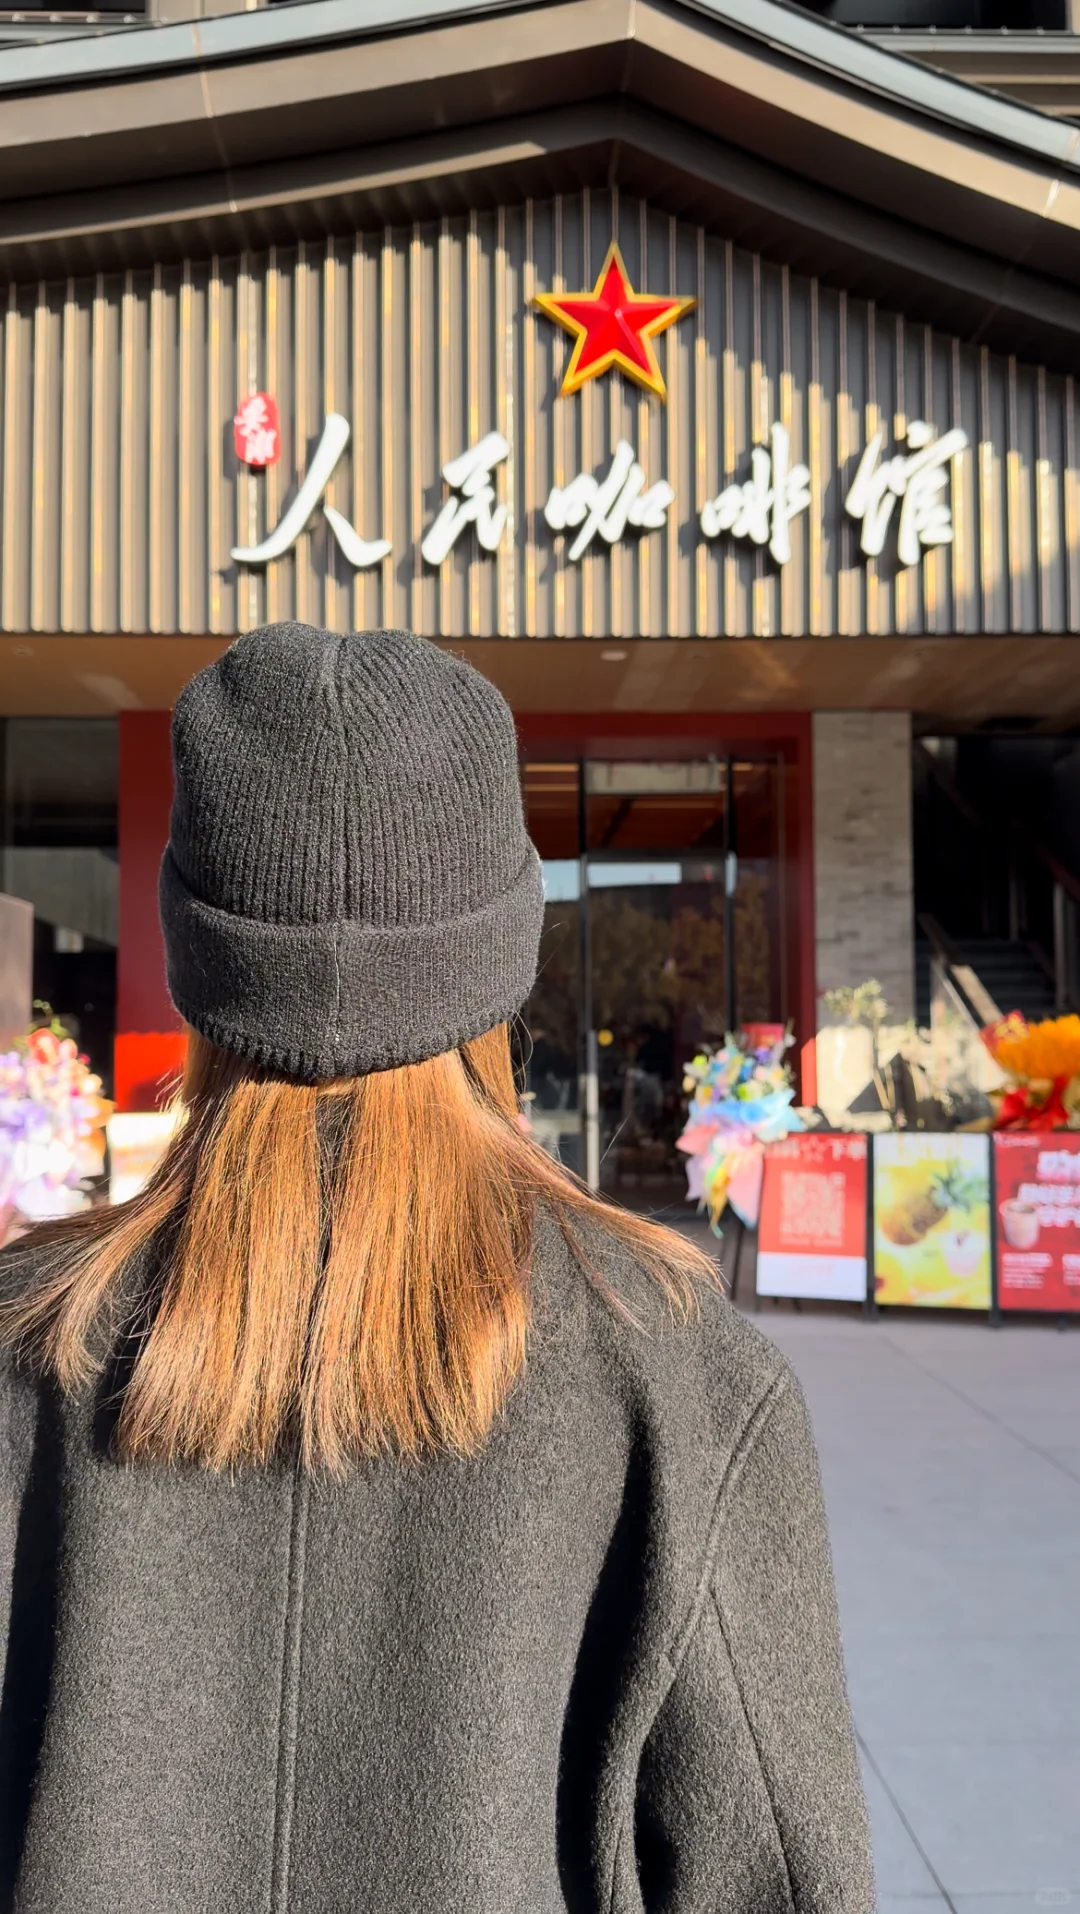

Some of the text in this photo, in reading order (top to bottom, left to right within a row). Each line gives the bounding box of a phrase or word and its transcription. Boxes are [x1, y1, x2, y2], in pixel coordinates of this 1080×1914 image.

[230, 412, 969, 566] 人民咖啡馆
